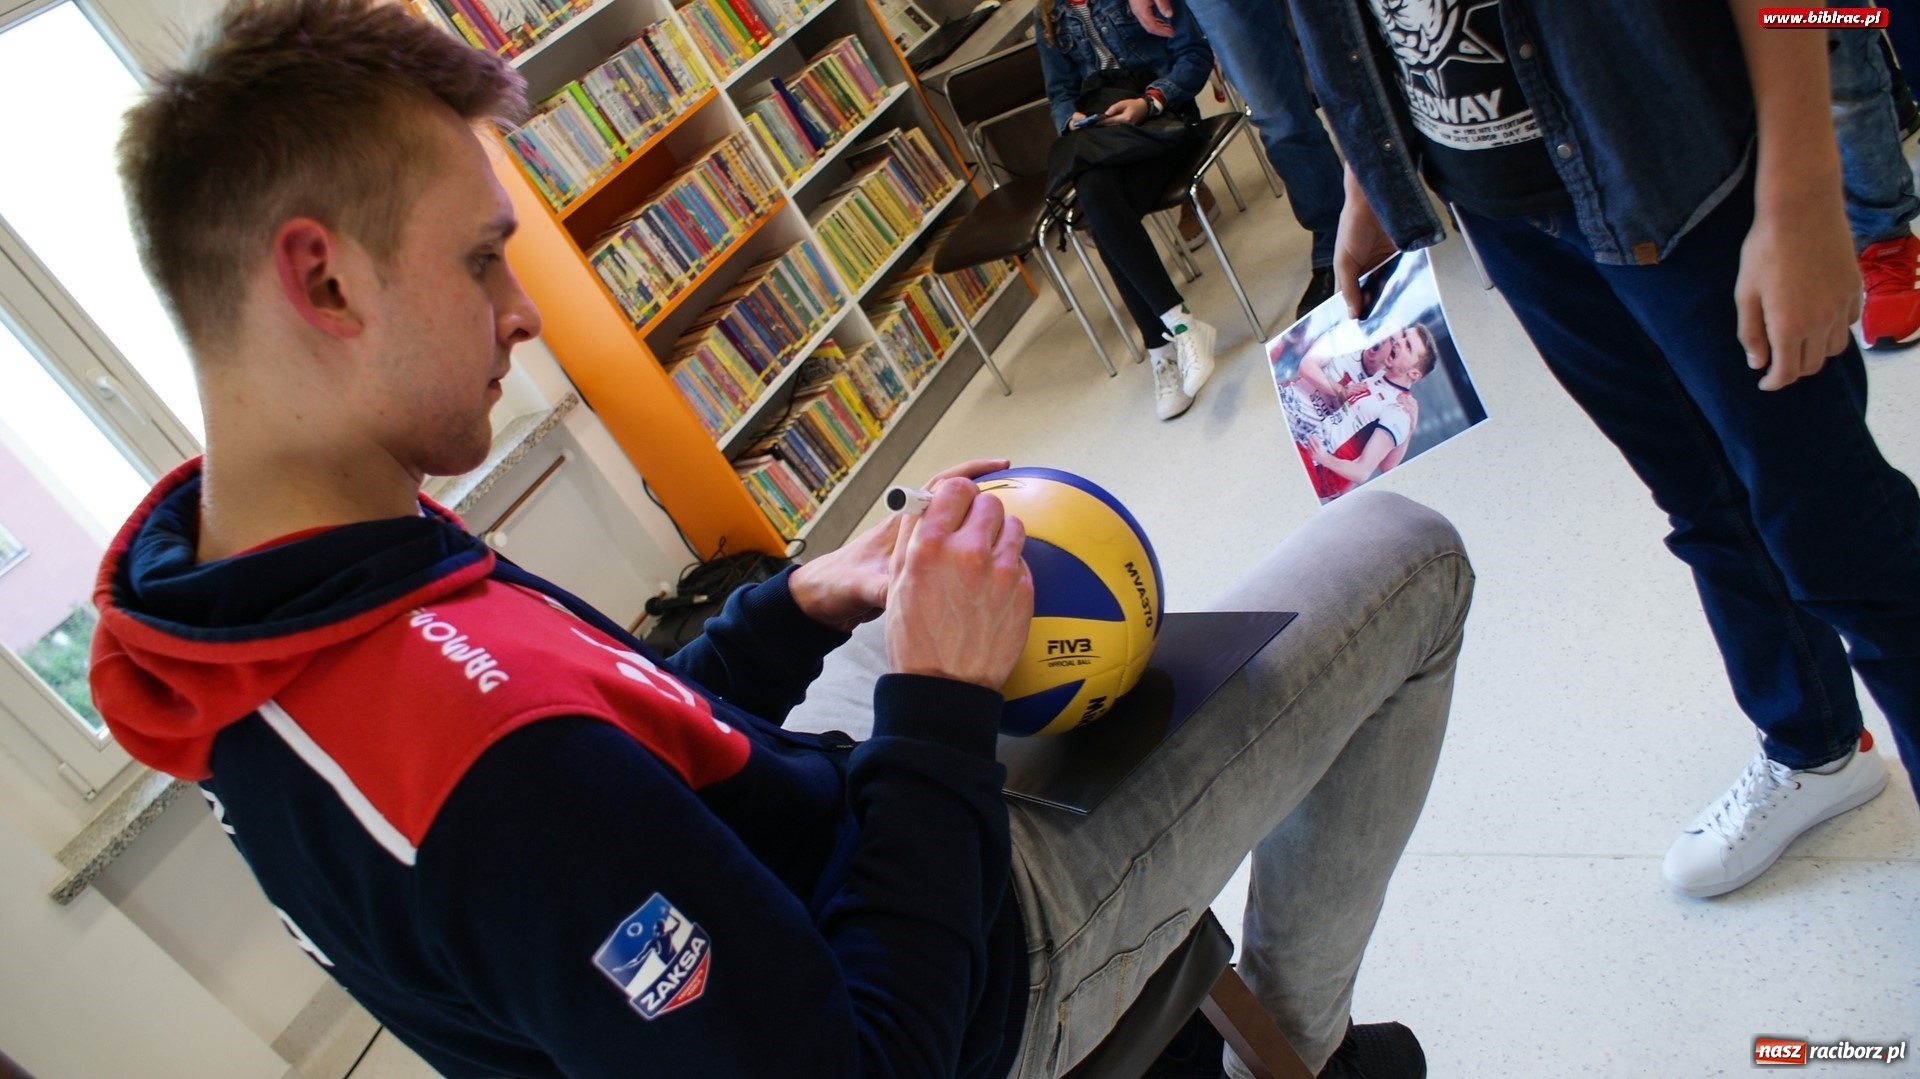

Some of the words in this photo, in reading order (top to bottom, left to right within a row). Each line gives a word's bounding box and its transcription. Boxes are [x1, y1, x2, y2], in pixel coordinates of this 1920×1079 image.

[1404, 83, 1502, 125] EEDWAY
[1502, 128, 1521, 140] DAY
[640, 937, 706, 1011] ZAKSA
